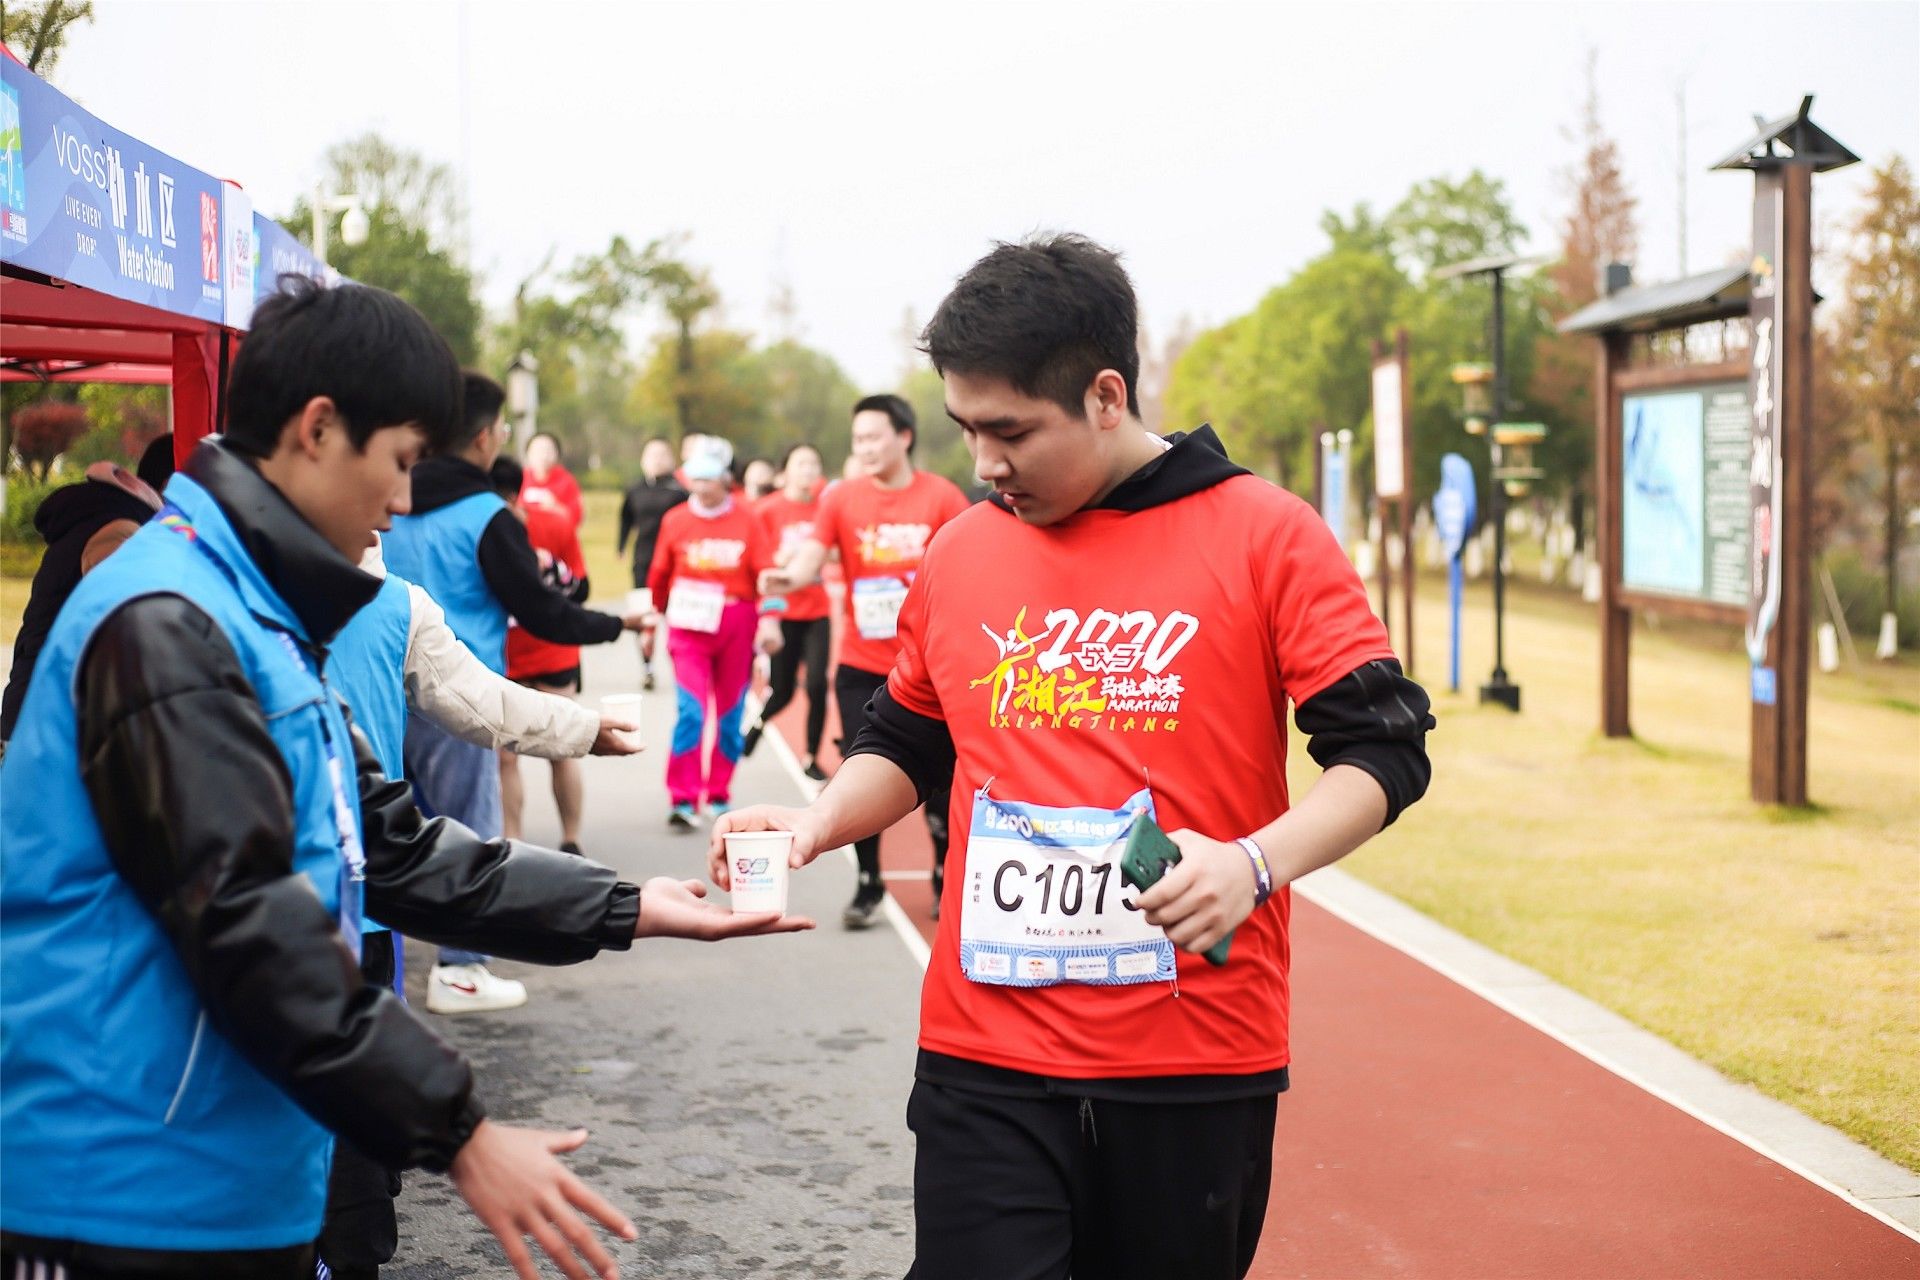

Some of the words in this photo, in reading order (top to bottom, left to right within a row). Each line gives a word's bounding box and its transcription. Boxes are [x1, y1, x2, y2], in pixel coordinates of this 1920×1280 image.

[53, 124, 106, 190] VOSS
[65, 194, 81, 221] LIVE
[81, 202, 102, 231] EVERY
[106, 146, 176, 249] 补水区
[117, 234, 144, 282] Water
[144, 244, 175, 291] Station
[1036, 607, 1200, 675] 2020
[1106, 698, 1180, 713] MARATHON
